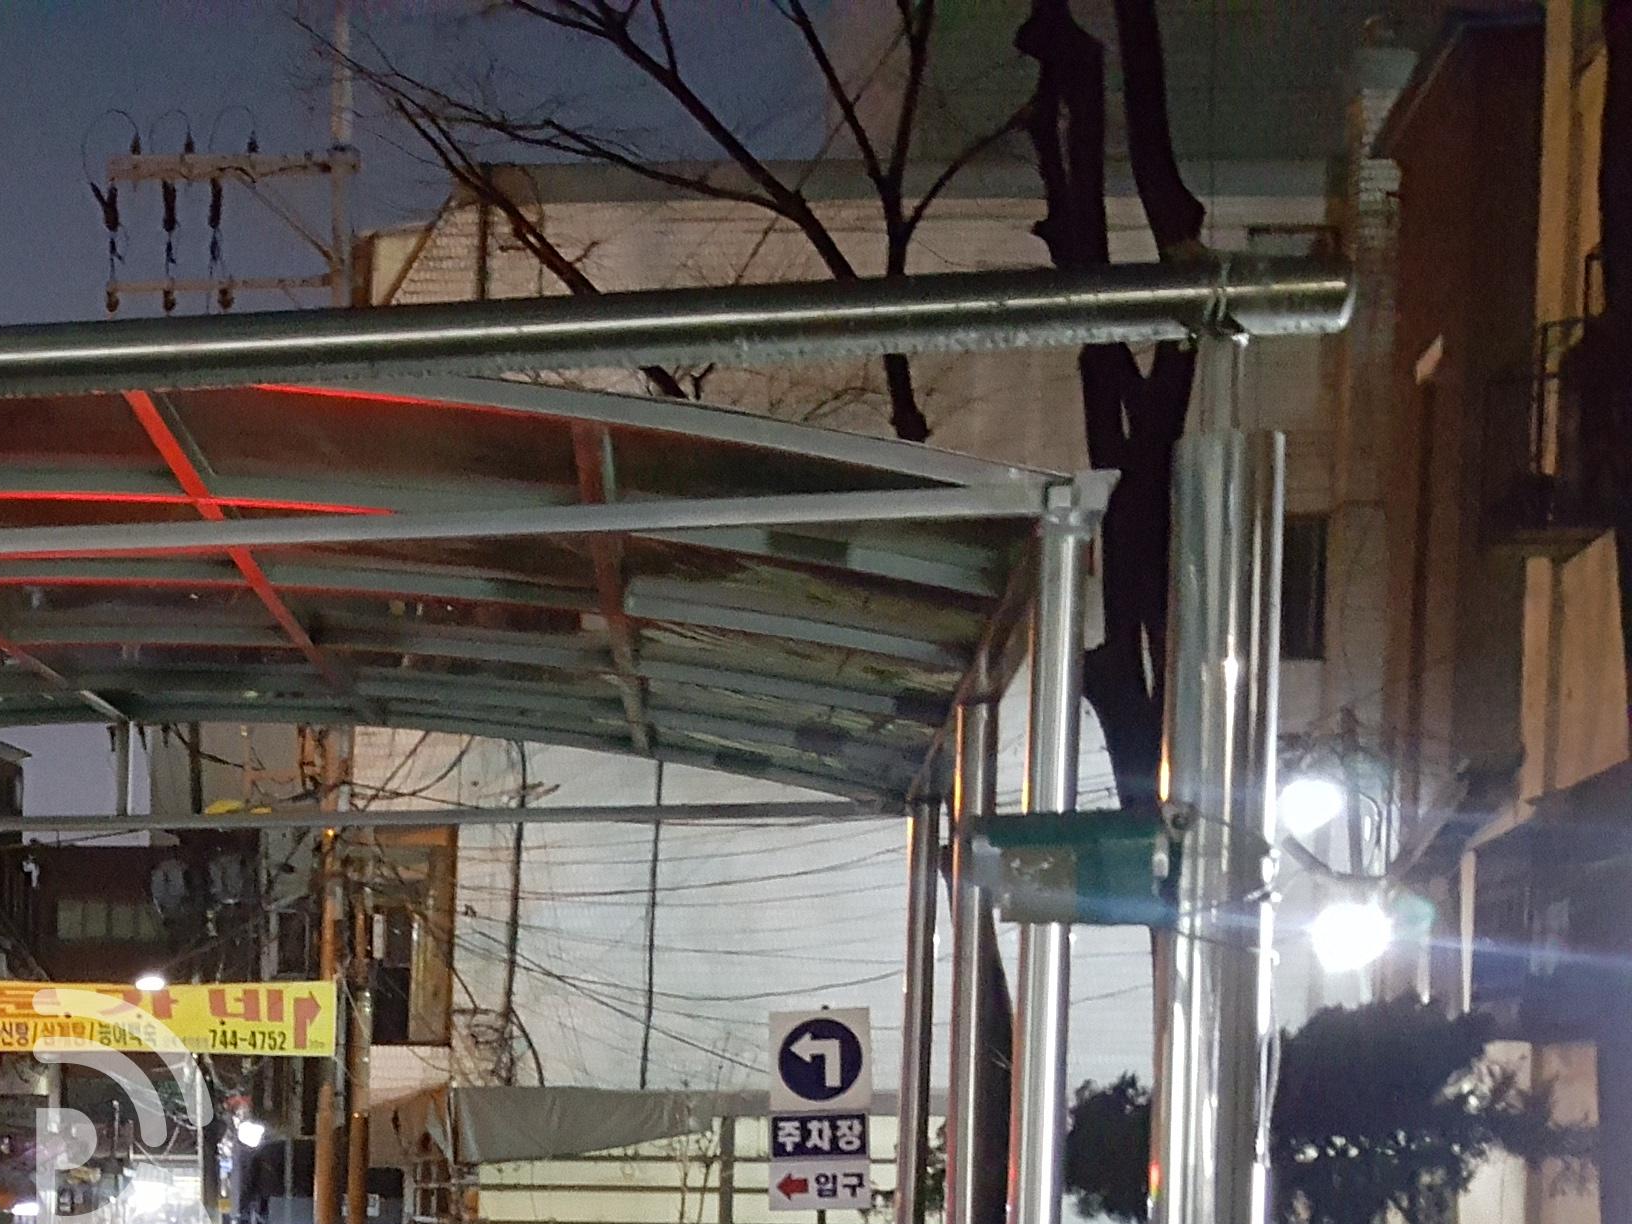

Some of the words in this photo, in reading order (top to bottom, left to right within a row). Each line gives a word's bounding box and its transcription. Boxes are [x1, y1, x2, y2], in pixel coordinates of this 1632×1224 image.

[208, 1028, 287, 1051] 744-4752
[777, 1117, 863, 1153] 주차장
[814, 1171, 865, 1199] 입구
